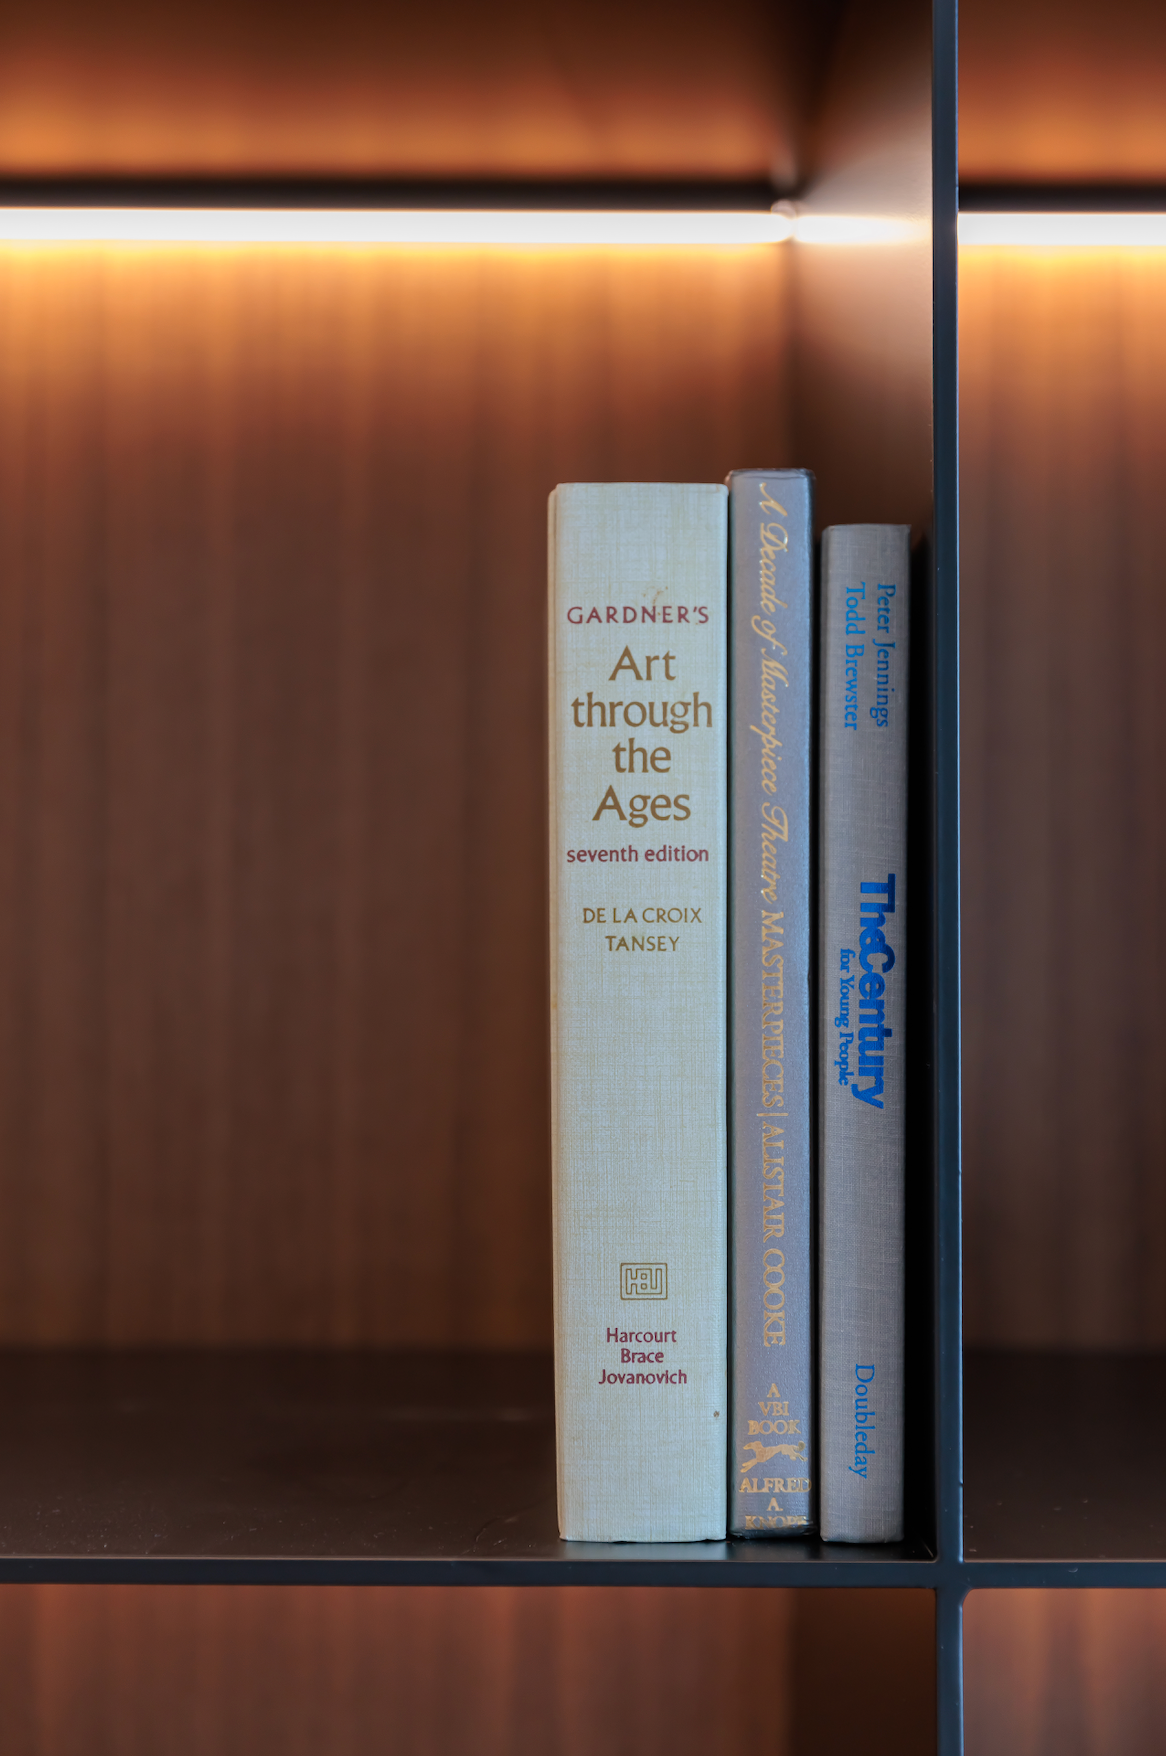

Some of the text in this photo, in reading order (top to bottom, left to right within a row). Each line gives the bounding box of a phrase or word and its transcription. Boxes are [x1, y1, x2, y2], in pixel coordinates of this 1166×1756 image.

[760, 522, 789, 616] Decade
[567, 606, 710, 625] GARDNER'S
[751, 615, 788, 656] of
[608, 645, 677, 681] Art
[844, 581, 866, 731] Todd Brewster
[870, 583, 897, 728] Peter Jennings
[571, 692, 713, 734] through
[750, 648, 789, 796] Masterpiece
[612, 737, 672, 773] the
[592, 785, 692, 828] Ages
[567, 844, 709, 863] seventh edition
[760, 802, 789, 904] Theatre
[583, 908, 702, 923] DE LA CROIX
[605, 936, 680, 952] TANSEY
[761, 909, 784, 1108] MASTERPIECES
[834, 948, 856, 1086] for Young People
[761, 1121, 785, 1243] ALISTAIR
[762, 1248, 785, 1347] COOKE
[606, 1327, 677, 1343] Harcourt
[620, 1348, 664, 1364] Brace
[598, 1369, 687, 1385] Jovanovich
[767, 1383, 781, 1398] A
[747, 1420, 801, 1435] BOOK
[758, 1401, 789, 1416] VBI
[848, 1363, 875, 1479] Doubleday
[738, 1477, 812, 1493] ALFRED
